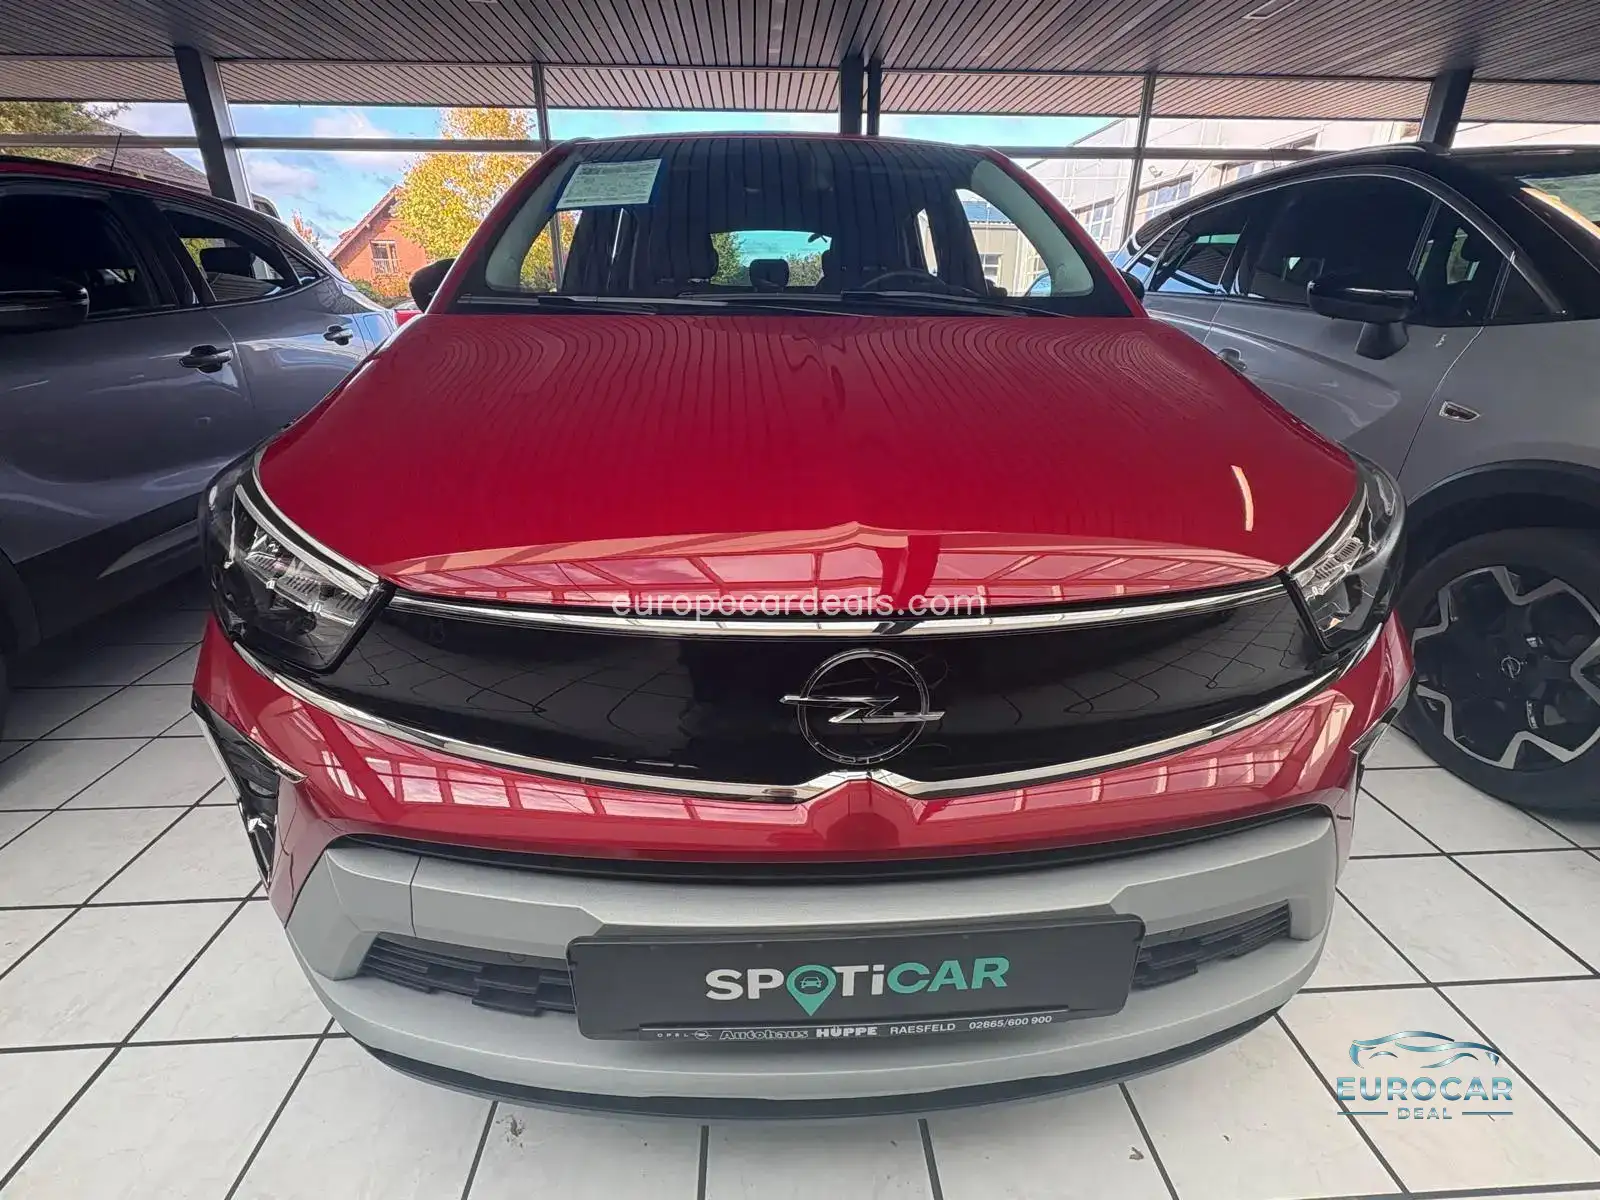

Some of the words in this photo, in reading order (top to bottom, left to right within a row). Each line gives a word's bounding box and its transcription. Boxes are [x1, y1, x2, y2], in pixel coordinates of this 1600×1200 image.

[719, 1029, 809, 1040] Autohaus
[816, 1025, 877, 1038] HÜPPE
[890, 1023, 956, 1035] RAESFELD
[1031, 1015, 1052, 1024] 900
